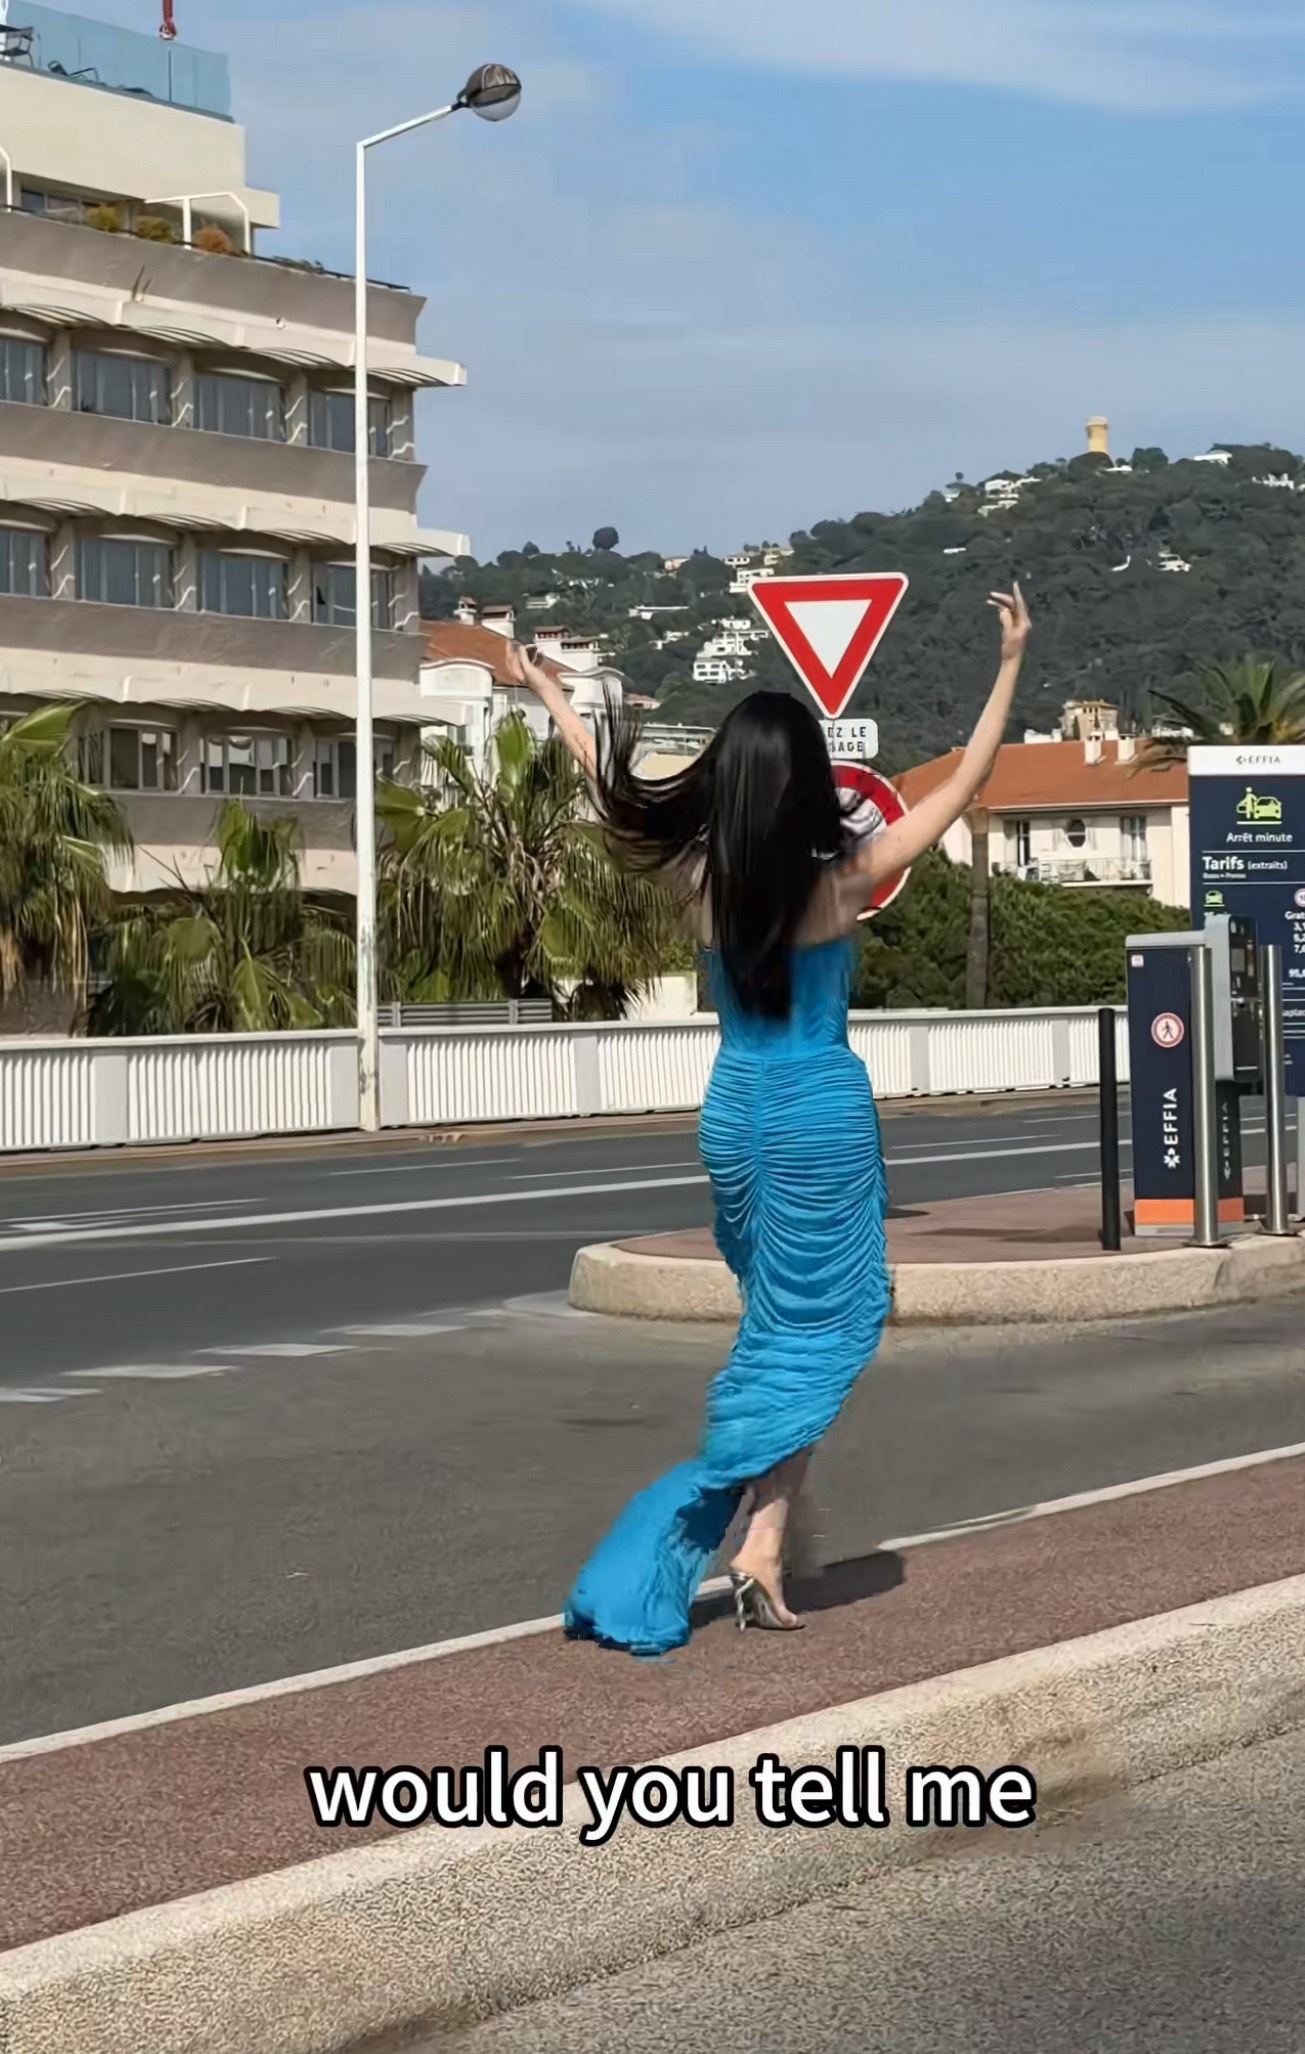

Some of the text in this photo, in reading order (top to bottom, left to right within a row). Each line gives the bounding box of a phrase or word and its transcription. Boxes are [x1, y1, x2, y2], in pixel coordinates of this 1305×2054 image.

[851, 726, 867, 738] LE
[1226, 832, 1293, 843] Arrêt minute
[1202, 856, 1288, 870] Tarifs (extraits)
[1163, 1088, 1178, 1145] EFFIA
